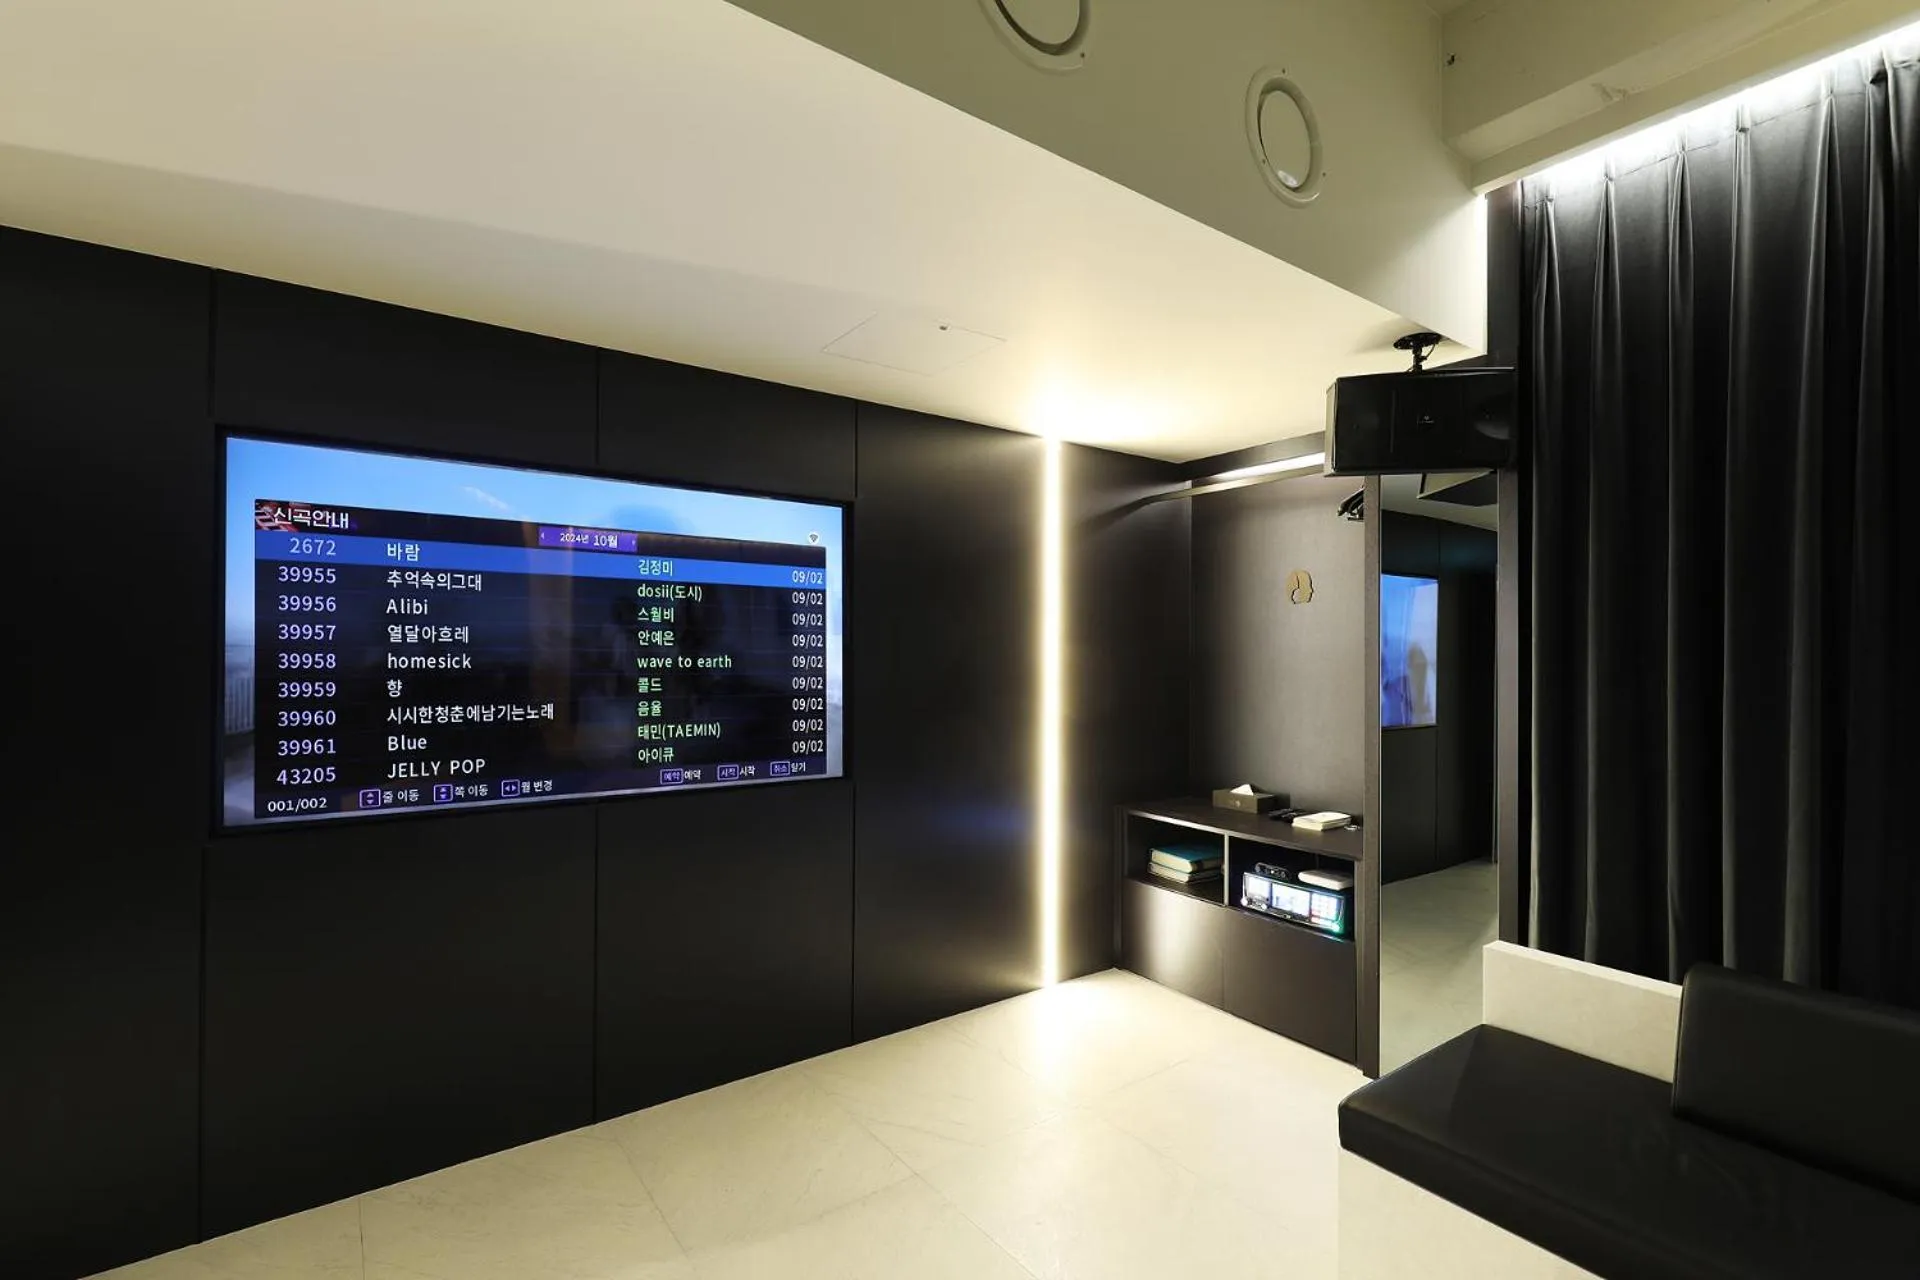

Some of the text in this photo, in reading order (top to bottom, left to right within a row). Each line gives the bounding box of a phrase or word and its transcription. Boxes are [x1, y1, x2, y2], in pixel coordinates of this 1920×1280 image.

[273, 507, 349, 529] 신곡안내
[289, 537, 337, 556] 2672
[560, 533, 618, 549] 2024년 10월
[387, 542, 420, 562] 바람
[278, 566, 337, 584] 39955
[637, 559, 673, 576] 김정미
[386, 569, 482, 591] 추억속의그대
[791, 570, 823, 585] 09/02
[636, 583, 703, 602] dosii(도시)
[791, 592, 823, 607] 09/02
[278, 595, 337, 612] 39956
[386, 598, 429, 615] Alibi
[637, 606, 675, 623] 스월비
[791, 613, 823, 627] 09/02
[278, 624, 337, 640] 39957
[387, 624, 469, 643] 열달아흐레
[637, 630, 675, 646] 안예은
[791, 635, 823, 649] 09/02
[278, 653, 337, 669] 39958
[387, 652, 472, 669] homesick
[636, 655, 732, 668] wave to earth
[791, 656, 823, 670] 09/02
[278, 681, 337, 698] 39959
[386, 679, 403, 698] 향
[637, 677, 662, 693] 콜드
[791, 677, 823, 691] 09/02
[637, 700, 662, 717] 음율
[791, 698, 823, 712] 09/02
[277, 710, 337, 727] 39960
[386, 703, 554, 725] 시시한청춘에남기는노래
[638, 722, 721, 740] 태민(TAEMIN)
[791, 719, 824, 733] 09/02
[277, 738, 337, 756] 39961
[387, 734, 427, 751] Blue
[791, 740, 824, 755] 09/02
[638, 747, 674, 763] 아이큐
[276, 766, 337, 785] 43205
[387, 758, 486, 779] JELLY POP
[684, 770, 701, 780] 예약
[468, 784, 489, 797] 이동
[533, 780, 553, 792] 변경
[397, 789, 420, 802] 이동
[267, 798, 327, 812] 001/002
